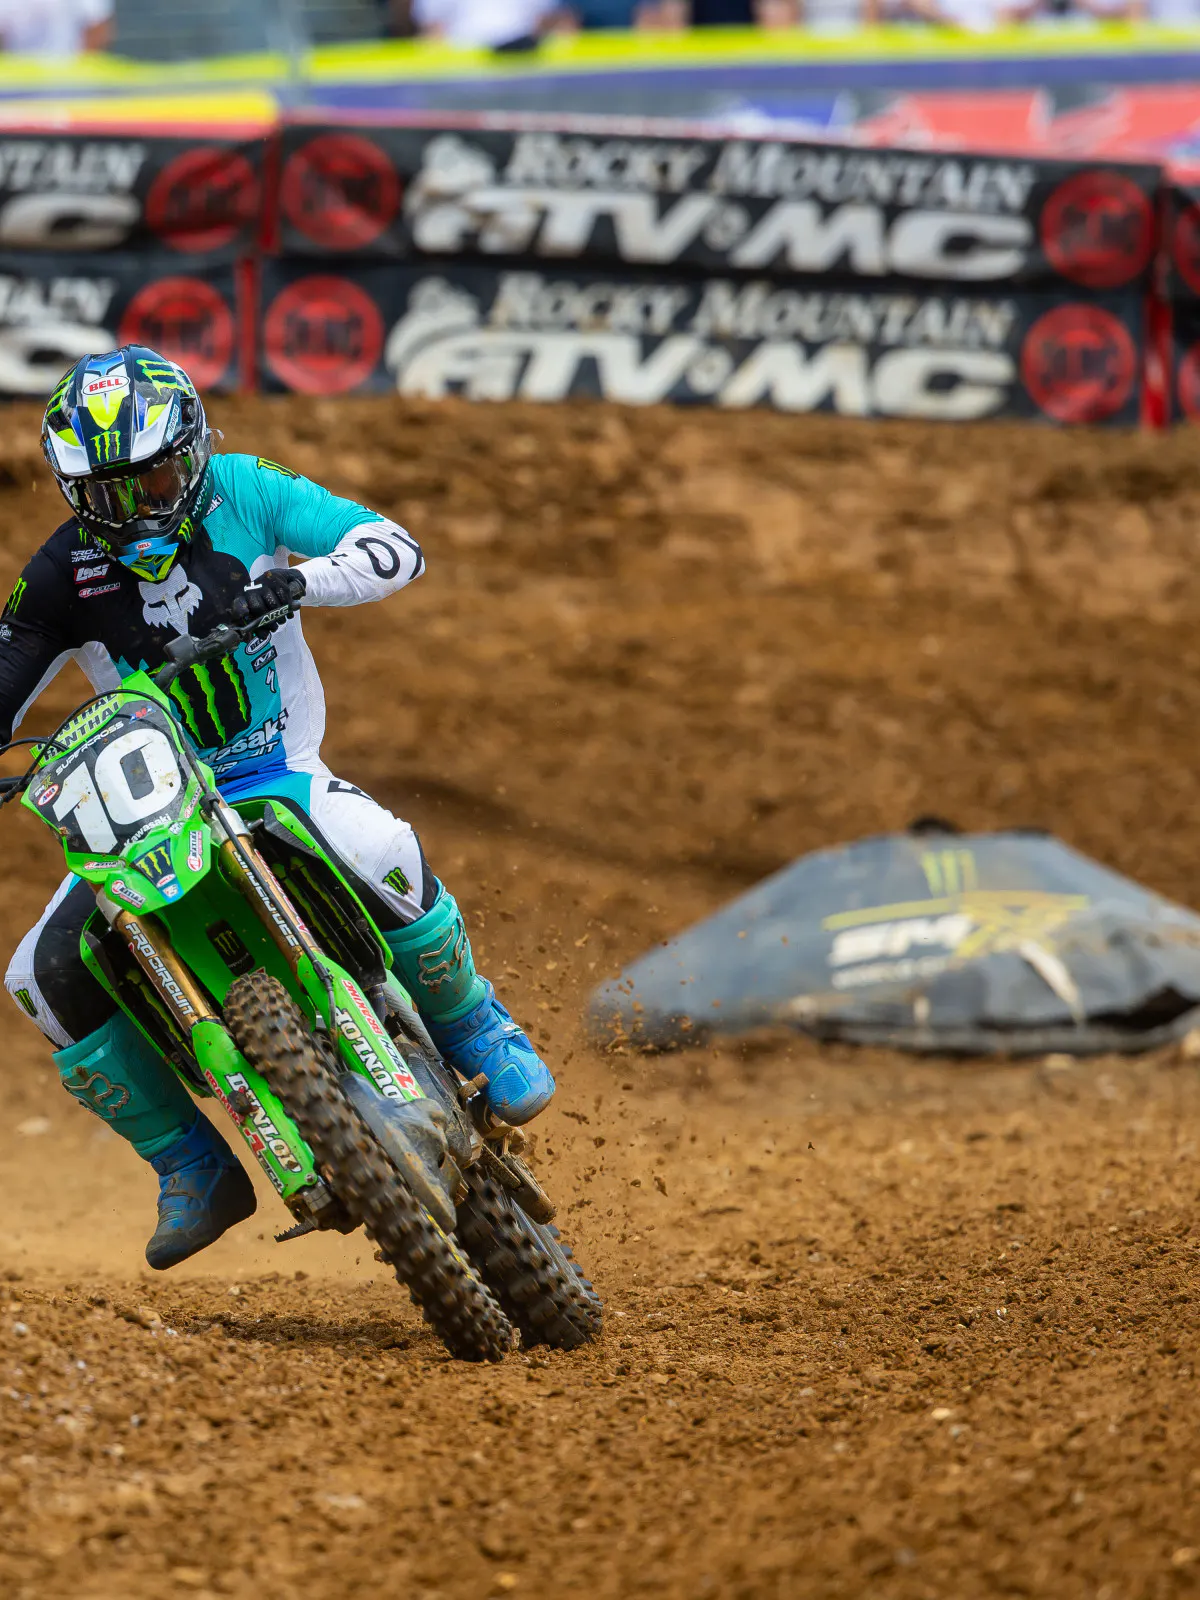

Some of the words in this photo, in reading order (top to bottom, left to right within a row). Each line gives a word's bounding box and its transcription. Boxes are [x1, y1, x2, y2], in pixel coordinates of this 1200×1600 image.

[506, 131, 704, 190] ROCKY
[710, 141, 1032, 210] MOUNTAIN
[490, 269, 688, 335] ROCKY
[692, 278, 1017, 350] MOUNTAIN
[88, 376, 124, 393] BELL
[55, 720, 125, 776] SUPERCROSS
[52, 727, 182, 853] 10
[123, 813, 172, 848] Kawasaki
[125, 922, 156, 958] PRO
[148, 956, 195, 1016] CIRCUIT
[341, 979, 385, 1036] BRAKING
